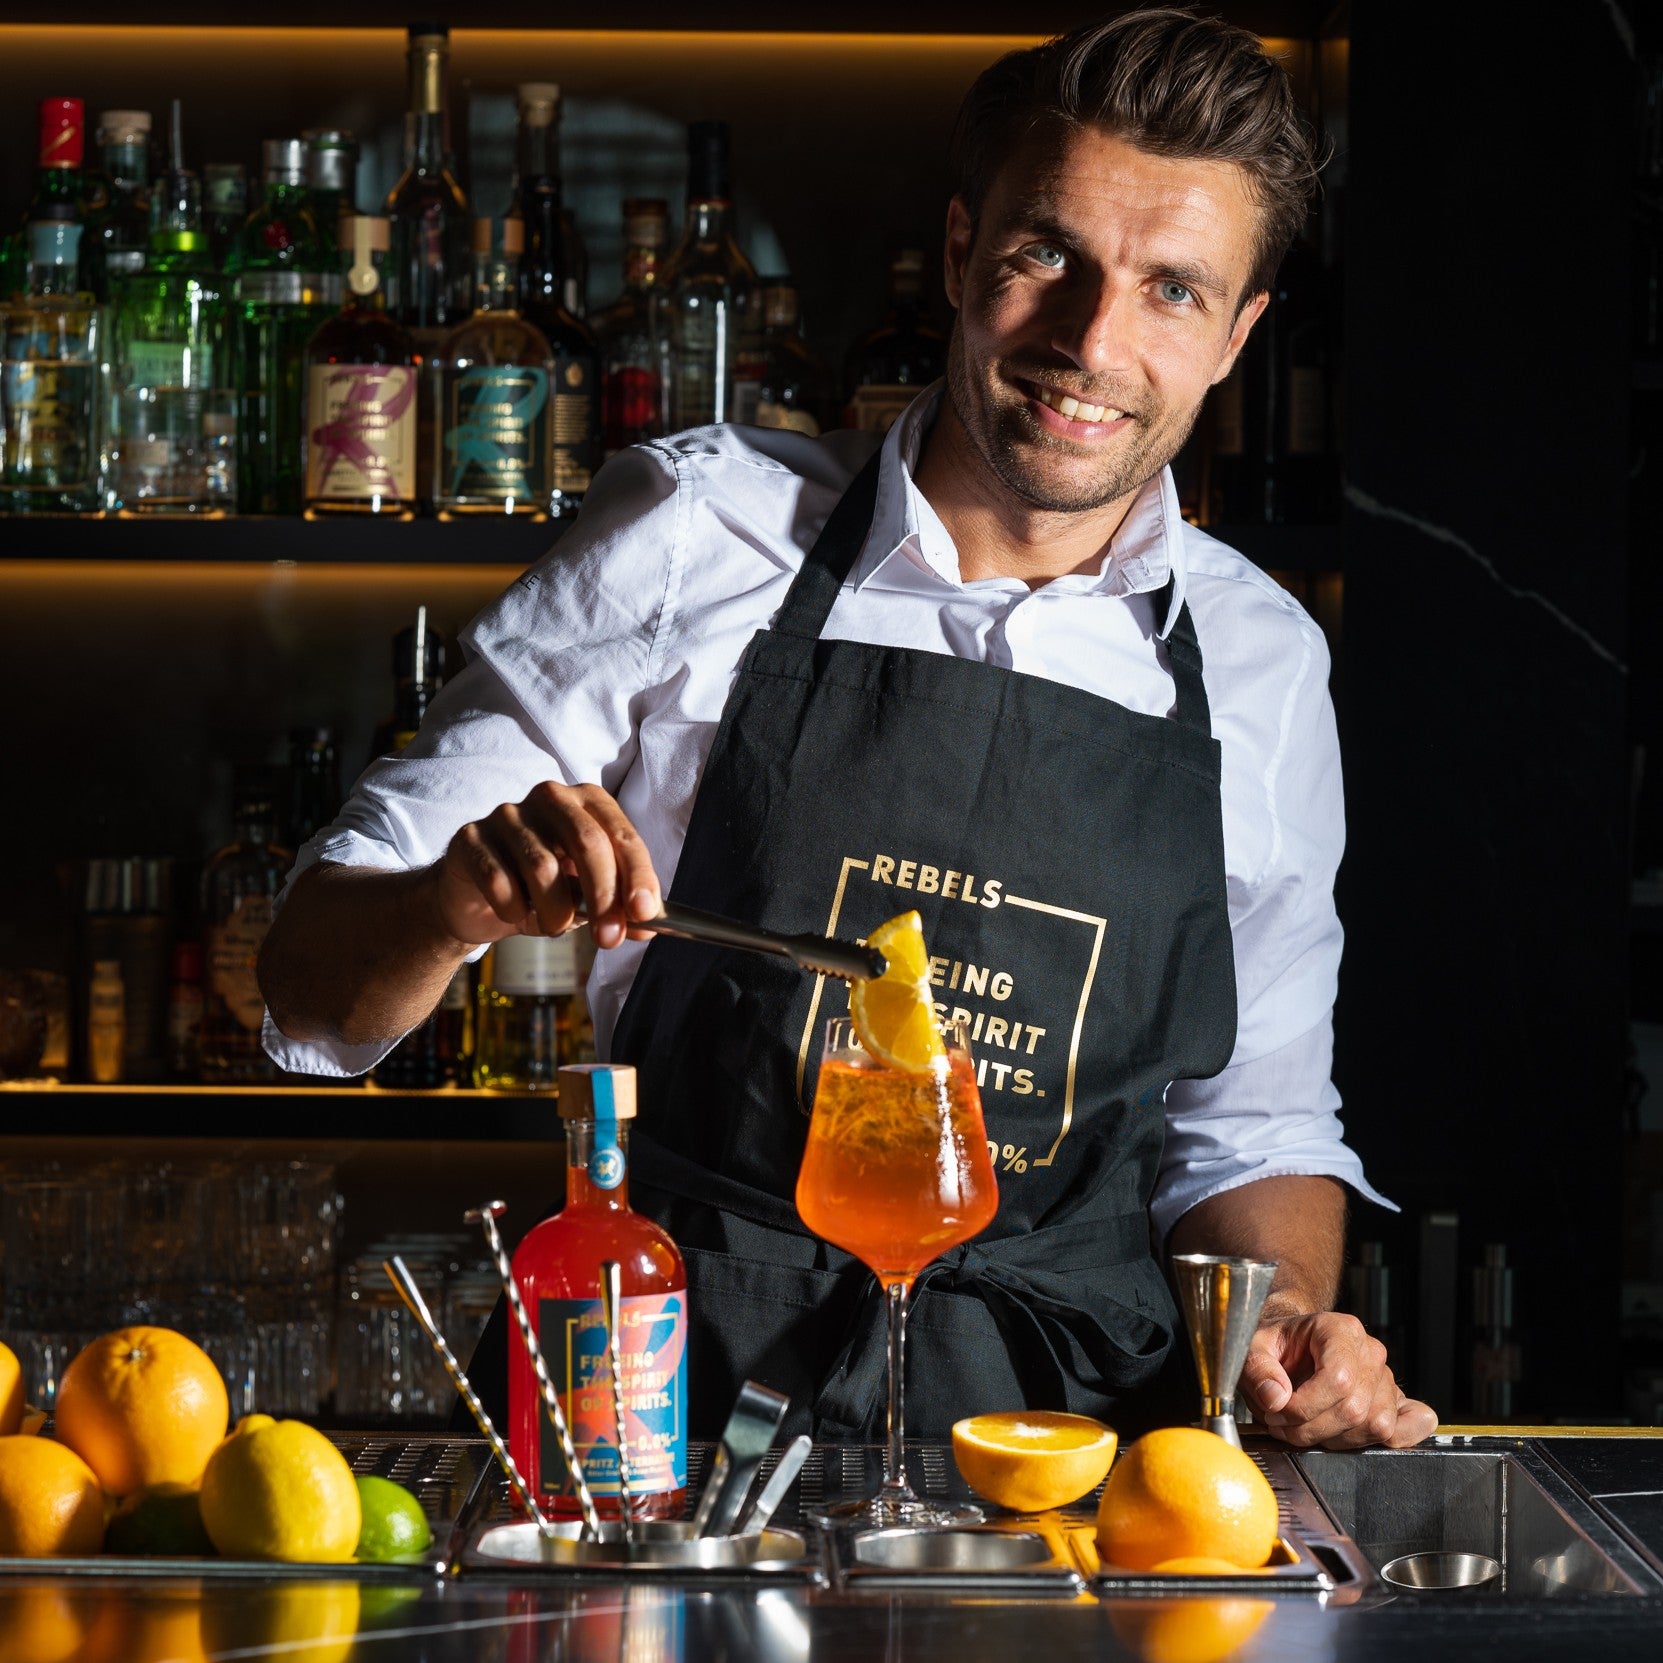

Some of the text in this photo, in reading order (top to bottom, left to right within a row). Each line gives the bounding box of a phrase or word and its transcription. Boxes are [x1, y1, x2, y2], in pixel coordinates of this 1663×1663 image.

[870, 853, 1003, 909] REBELS
[580, 1310, 641, 1328] RELS
[581, 1457, 614, 1470] PRITZ
